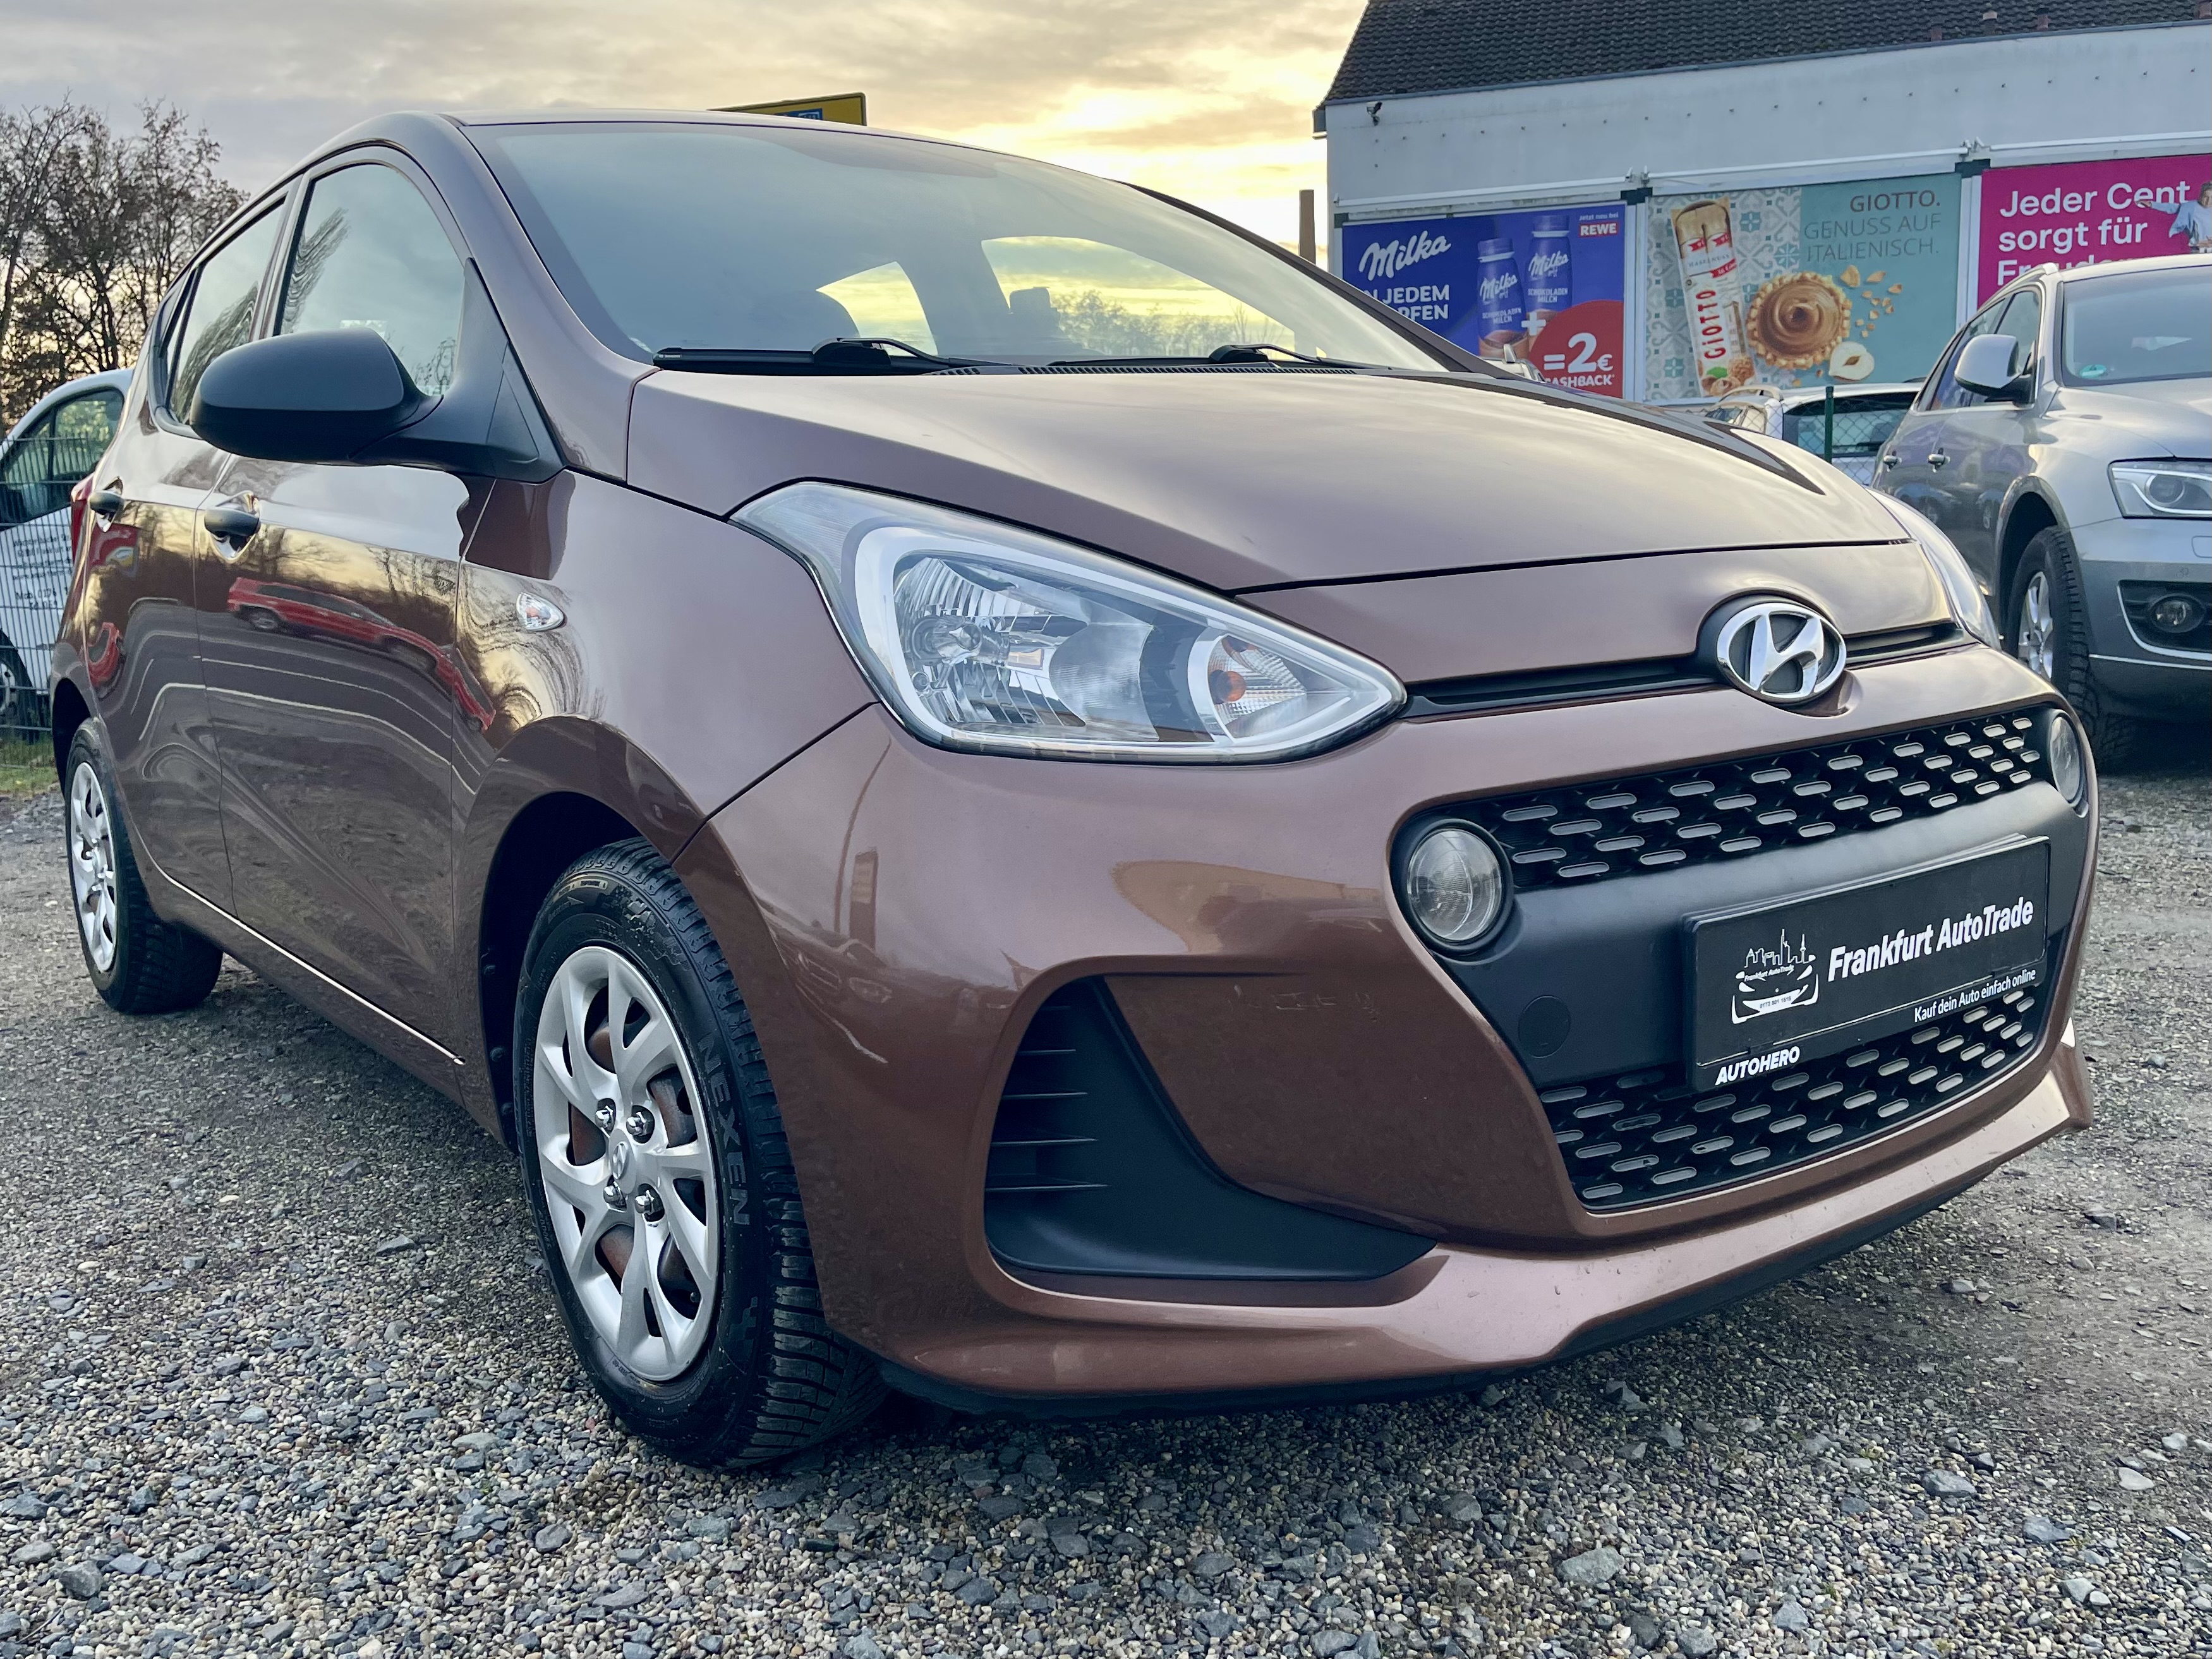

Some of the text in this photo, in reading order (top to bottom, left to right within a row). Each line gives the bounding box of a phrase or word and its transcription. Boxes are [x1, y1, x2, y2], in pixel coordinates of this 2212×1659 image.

[1849, 189, 1941, 213] GIOTTO.
[1999, 181, 2191, 218] Jeder Cent
[1580, 222, 1617, 236] REWE
[1804, 212, 1942, 239] GENUSS AUF
[1998, 216, 2148, 254] sorgt für
[1358, 230, 1452, 281] Milka
[1528, 250, 1569, 277] Milka
[1807, 236, 1940, 263] ITALIENISCH.
[1382, 284, 1450, 305] JEDEM
[1479, 272, 1518, 302] Milka
[1397, 304, 1449, 322] PFEN
[1828, 896, 2034, 982] Frankfurt AutoTrade
[1914, 968, 2036, 1023] Kauf dein Auto einfach online
[1715, 1046, 1801, 1087] AUTOHERO
[698, 1032, 750, 1226] NEXEN
